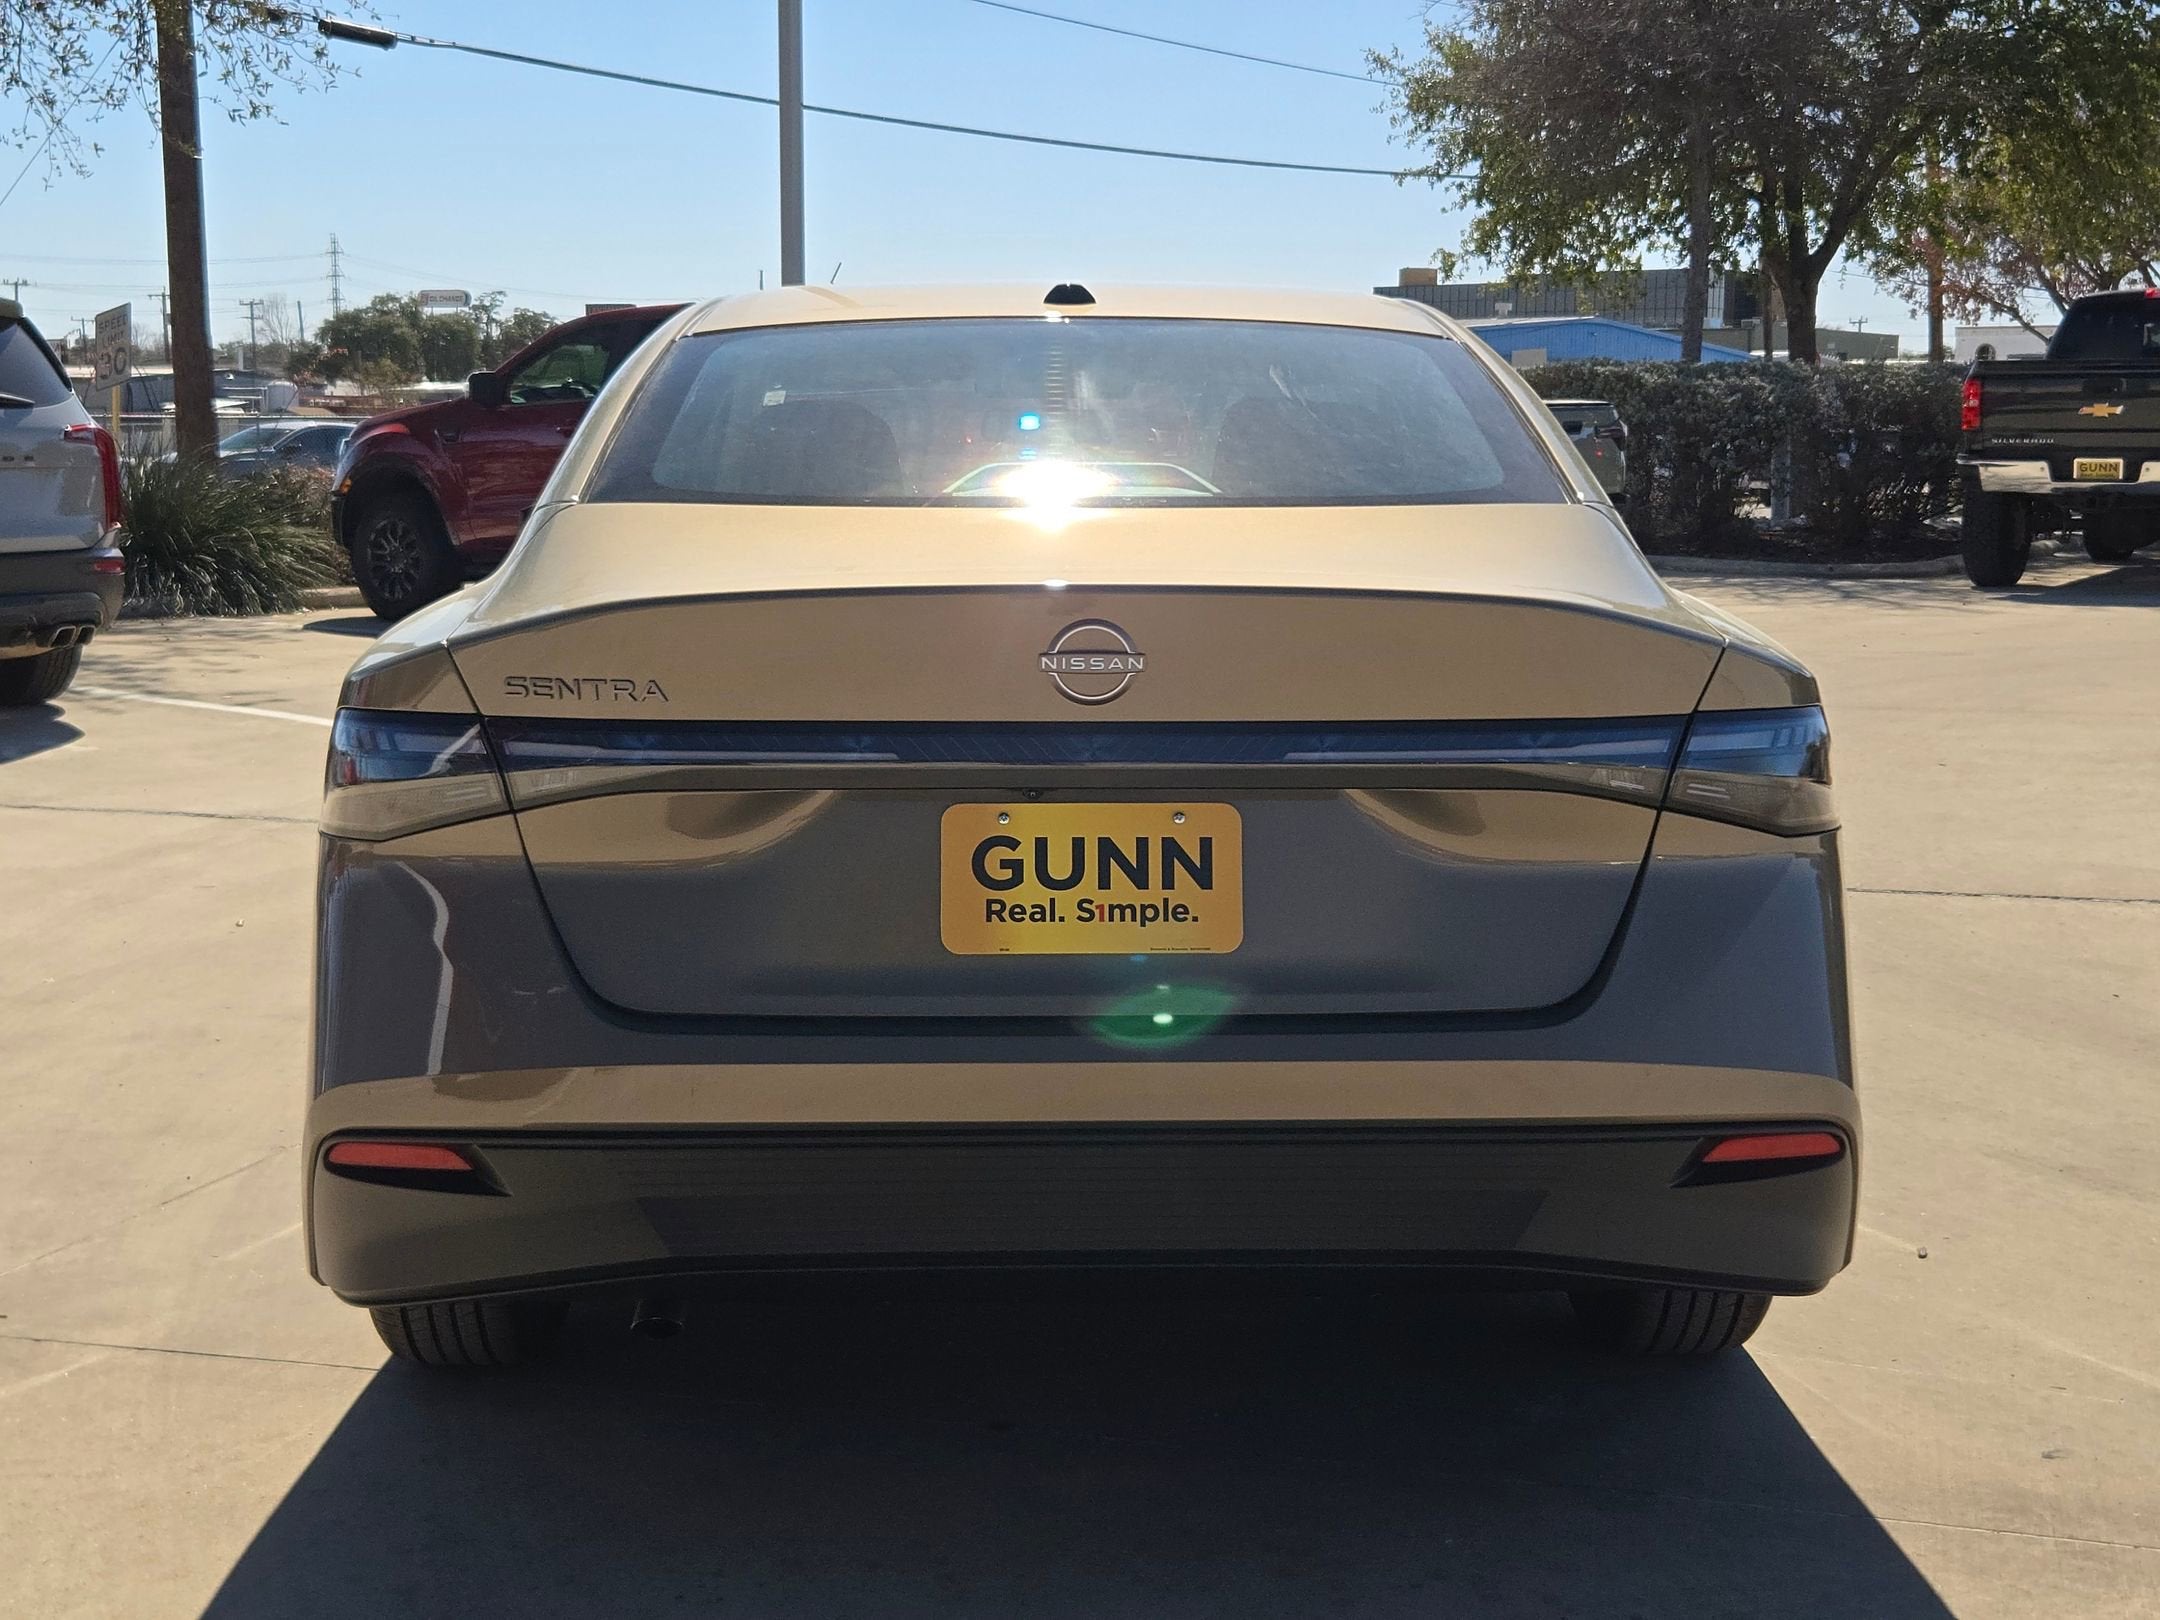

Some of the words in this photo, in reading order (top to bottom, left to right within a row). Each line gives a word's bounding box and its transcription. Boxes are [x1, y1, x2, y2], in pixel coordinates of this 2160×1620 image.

[98, 313, 128, 334] SPEED
[102, 331, 124, 347] LIMIT
[2079, 463, 2119, 473] GUNN
[1041, 657, 1144, 670] NISSAN
[504, 675, 669, 703] SENTRA
[971, 835, 1213, 891] GUNN
[985, 897, 1065, 923] Real.
